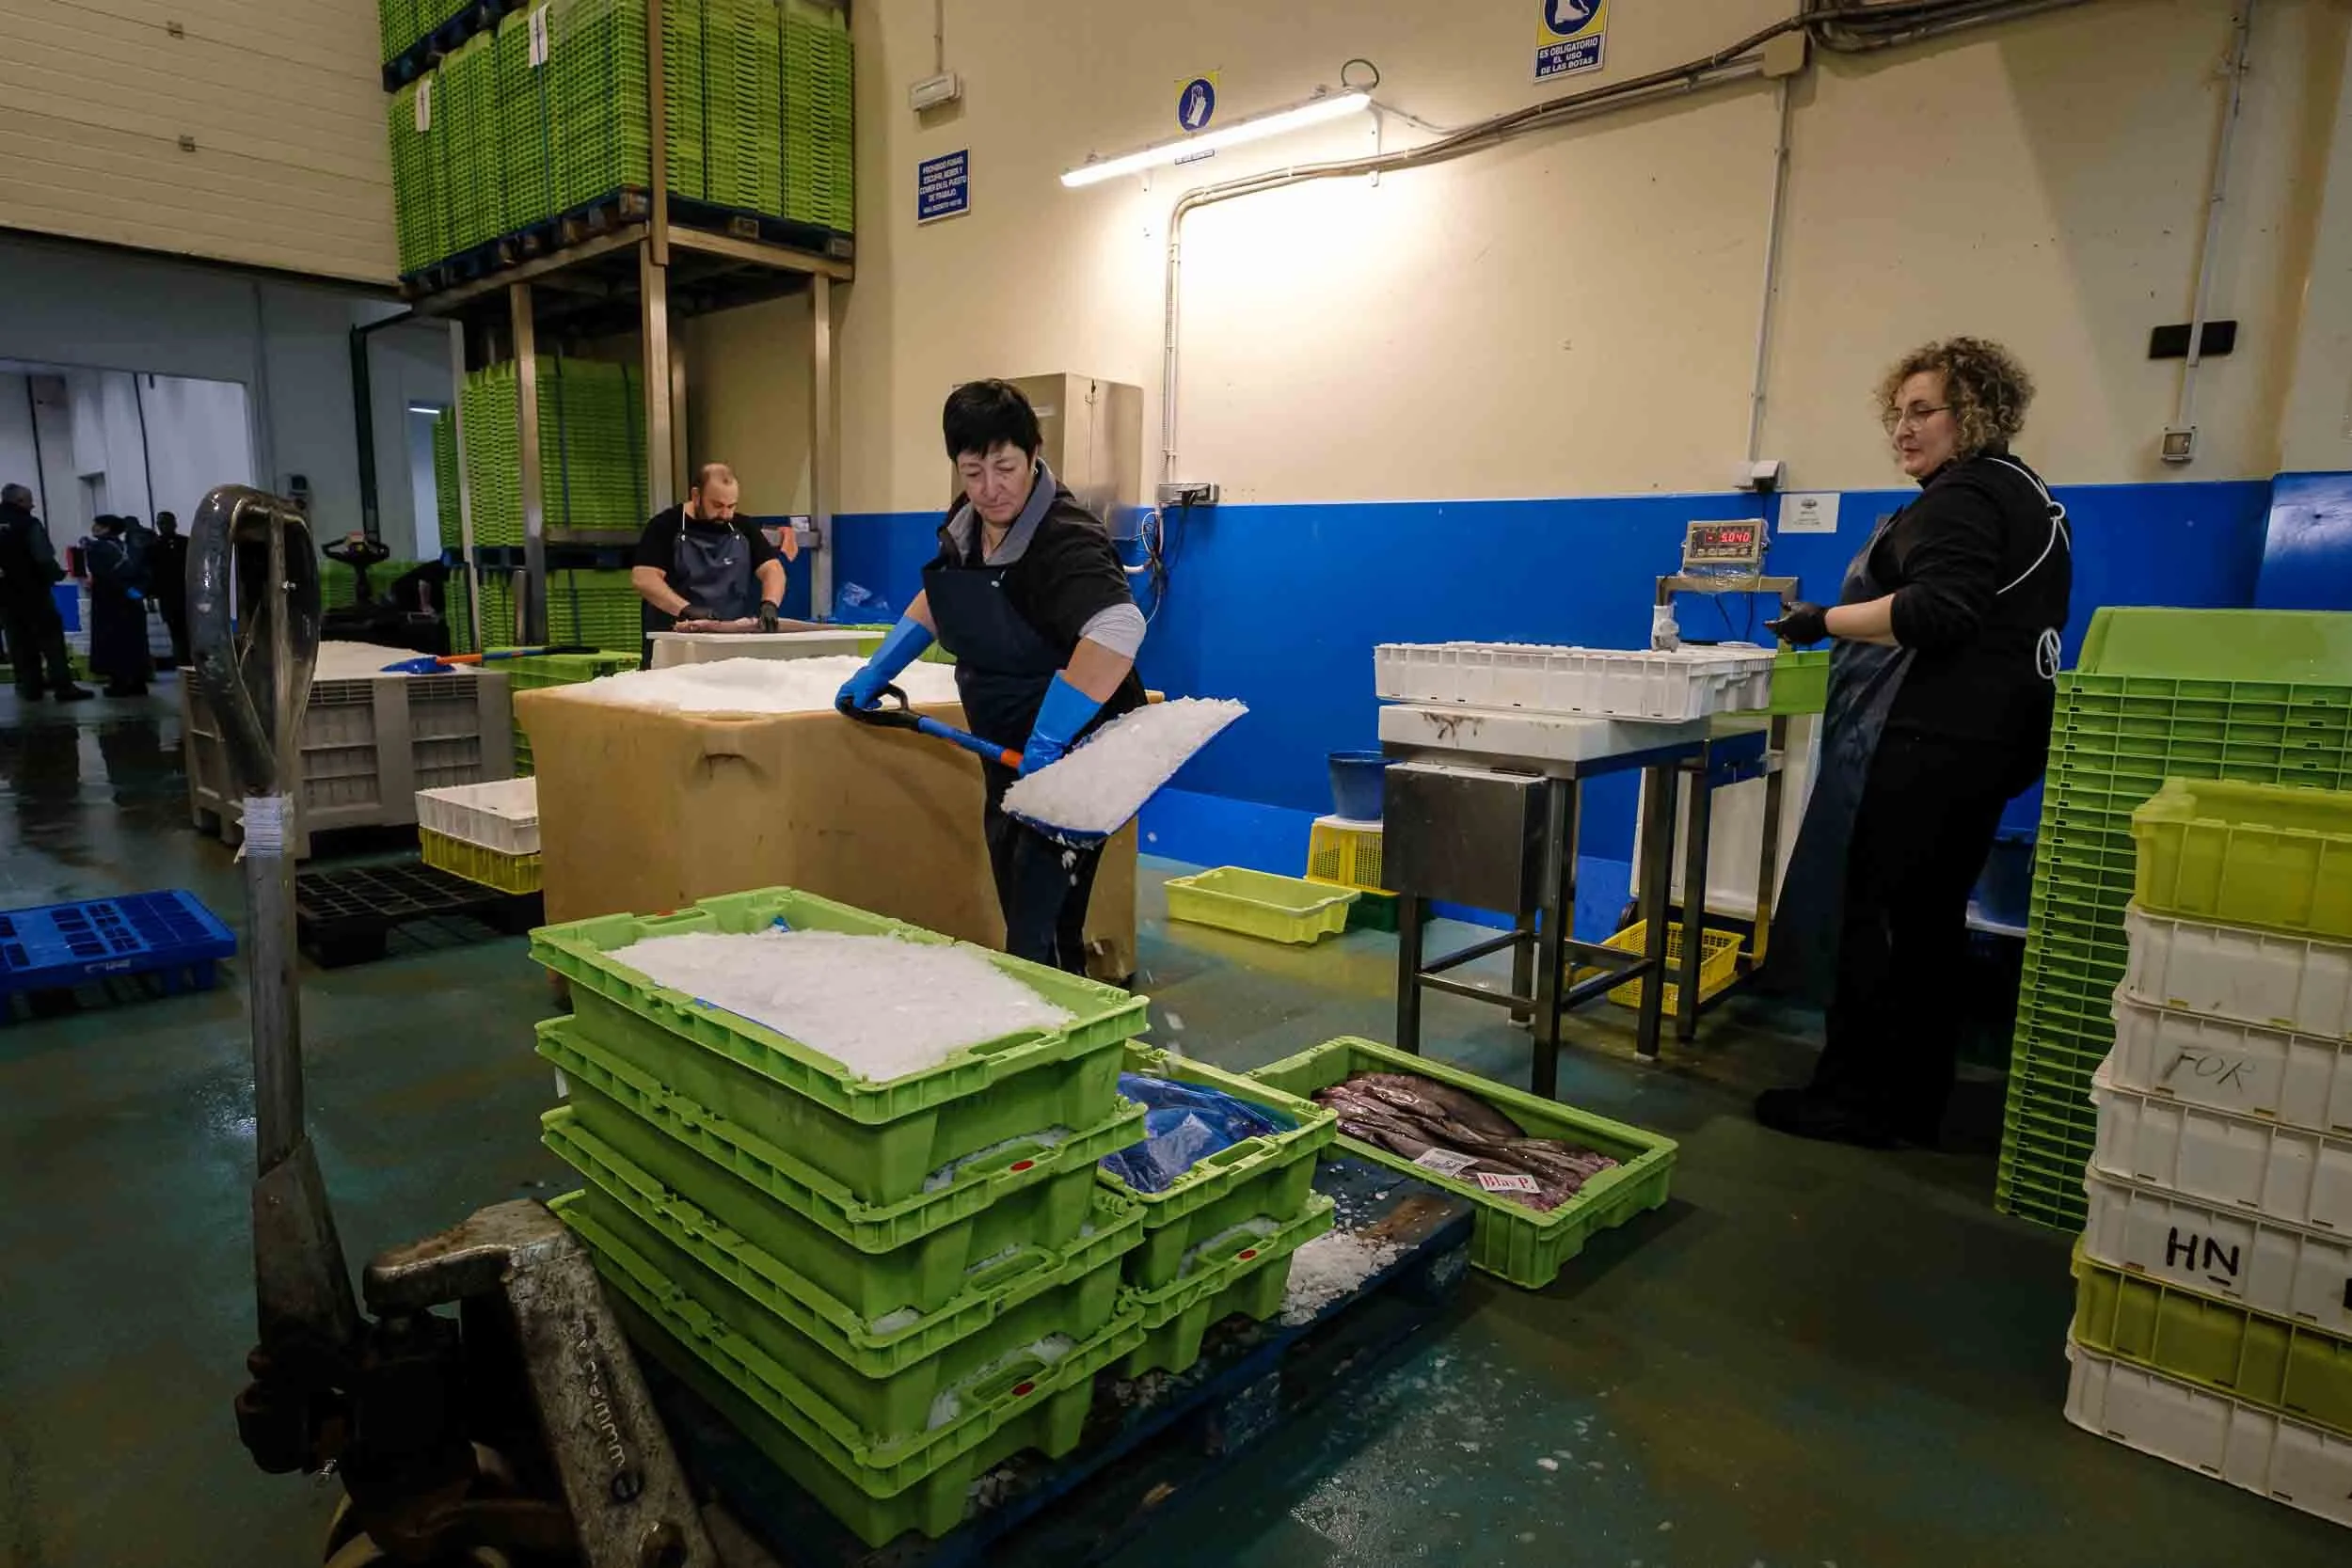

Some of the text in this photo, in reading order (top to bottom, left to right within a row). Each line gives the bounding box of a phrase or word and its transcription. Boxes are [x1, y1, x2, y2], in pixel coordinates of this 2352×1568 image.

[1540, 37, 1598, 58] ES OBLIGATORIO
[1566, 51, 1582, 60] USO
[1541, 56, 1593, 75] DE LAS BOTAS
[2165, 1226, 2240, 1277] HN
